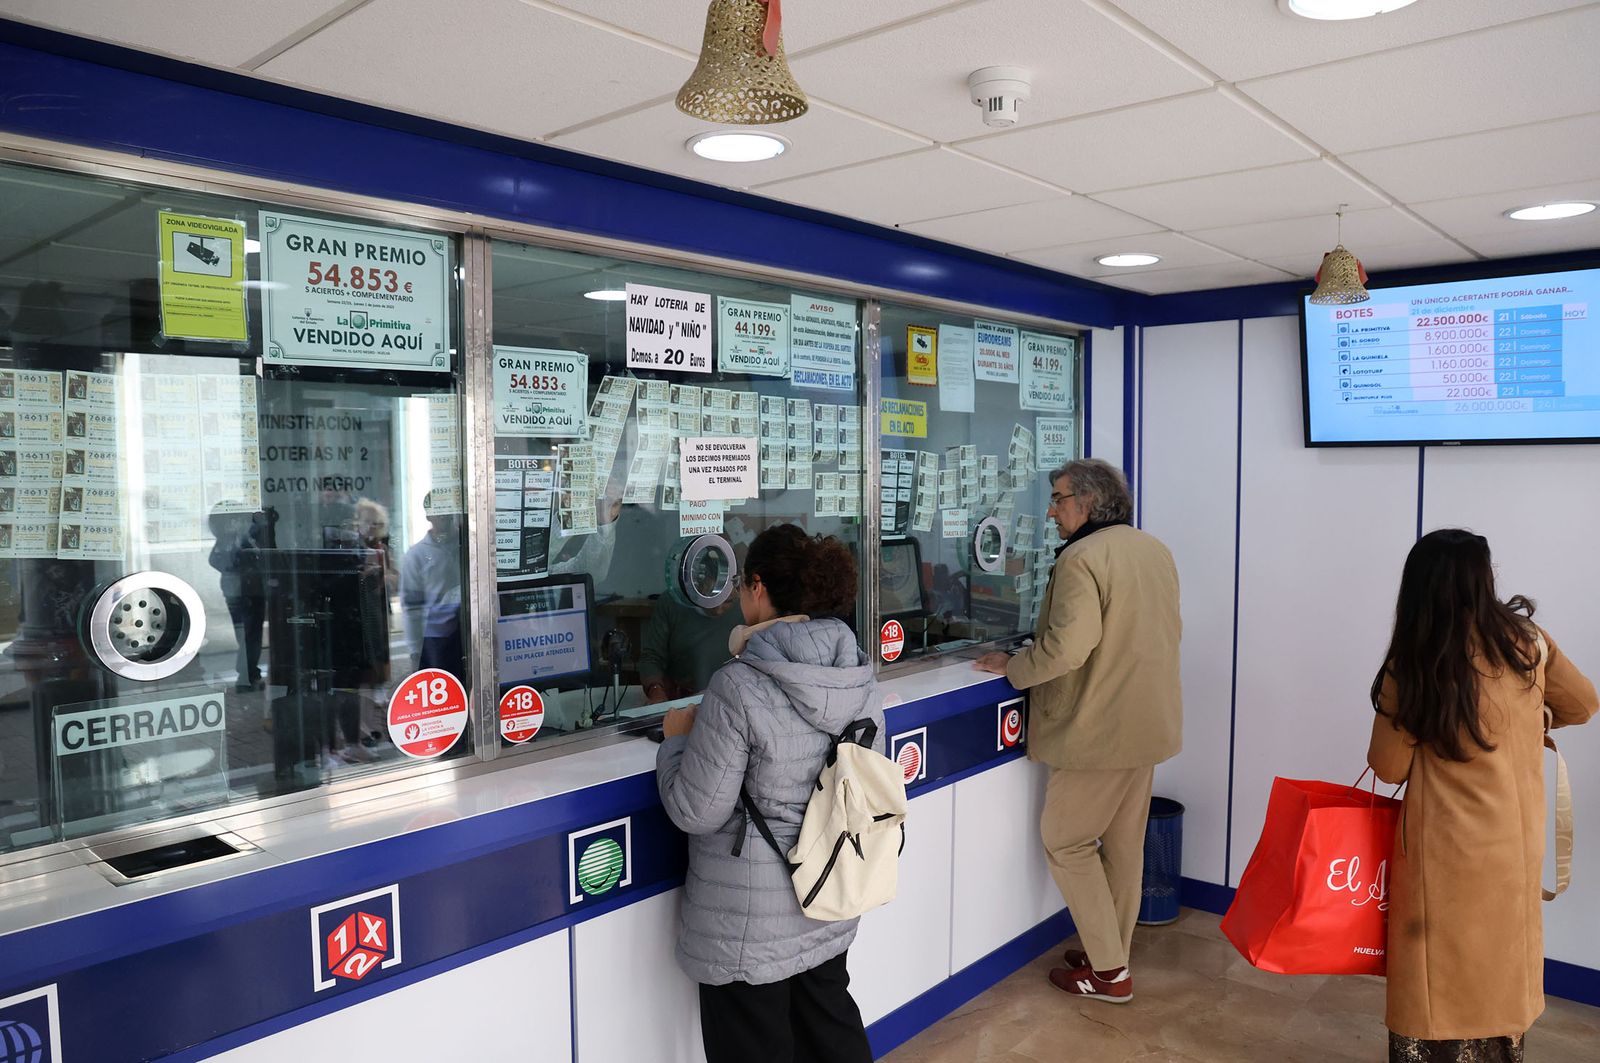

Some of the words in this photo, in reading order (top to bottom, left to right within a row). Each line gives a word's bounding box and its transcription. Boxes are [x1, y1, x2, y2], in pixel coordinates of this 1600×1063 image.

[166, 219, 185, 227] ZONA
[188, 222, 238, 233] VIDEOVIGILADA
[286, 234, 347, 257] GRAN
[354, 243, 426, 266] PREMIO
[307, 261, 398, 292] 54.853
[312, 286, 344, 296] ACIERTOS
[352, 290, 414, 302] COMPLEMENTARIO
[1452, 293, 1500, 302] ACERTANTE
[1501, 289, 1533, 298] PODRÍA
[630, 294, 648, 306] HAY
[655, 297, 688, 311] LOTERIA
[695, 302, 705, 313] DE
[810, 304, 834, 312] AVISO
[1435, 305, 1474, 314] diciembre
[728, 308, 751, 319] GRAN
[754, 311, 782, 322] PREMIO
[1336, 308, 1373, 319] BOTES
[1417, 314, 1488, 327] 22.500.000€
[1499, 313, 1509, 321] 21
[337, 316, 348, 325] La
[370, 319, 411, 330] Primitiva
[629, 316, 665, 335] NAVIDAD
[669, 324, 674, 340] y
[735, 321, 770, 336] 44.199
[294, 328, 374, 347] VENDIDO
[381, 333, 423, 350] AQUÍ
[1425, 328, 1488, 341] 8.900.000€
[1499, 328, 1511, 336] 22
[978, 333, 1011, 347] EURODREAMS
[1499, 343, 1511, 351] 22
[1028, 342, 1045, 353] GRAN
[1046, 345, 1067, 356] PREMIO
[1428, 343, 1488, 355] 1.600.000€
[655, 353, 658, 363] a
[664, 349, 684, 365] 20
[690, 353, 705, 367] Euros
[730, 354, 761, 364] VENDIDO
[763, 356, 779, 366] AQUÍ
[978, 360, 997, 368] DURANTE
[1033, 356, 1059, 371] 44.199
[1432, 358, 1488, 370] 1.160.000€
[1499, 358, 1511, 366] 22
[500, 358, 530, 370] GRAN
[534, 361, 574, 373] PREMIO
[510, 374, 558, 390] 54.853
[1442, 373, 1488, 383] 50.000€
[1499, 373, 1511, 381] 22
[1028, 391, 1051, 400] VENDIDO
[1053, 392, 1065, 402] AQUÍ
[1446, 387, 1492, 398] 22.000€
[1502, 387, 1514, 396] 22
[502, 415, 546, 424] VENDIDO
[548, 414, 572, 425] AQUÍ
[903, 422, 914, 433] ACTO
[360, 447, 368, 461] 2
[508, 459, 538, 469] BOTES
[264, 477, 307, 493] GATO
[884, 624, 898, 638] +18
[505, 632, 574, 650] BIENVENIDO
[404, 677, 449, 708] +18
[507, 692, 533, 710] +18
[61, 700, 223, 750] CERRADO
[1327, 856, 1361, 892] El
[362, 916, 383, 947] X
[334, 924, 347, 955] 1
[1354, 947, 1384, 956] HUELVA
[344, 953, 379, 976] 2
[1076, 980, 1096, 993] N
